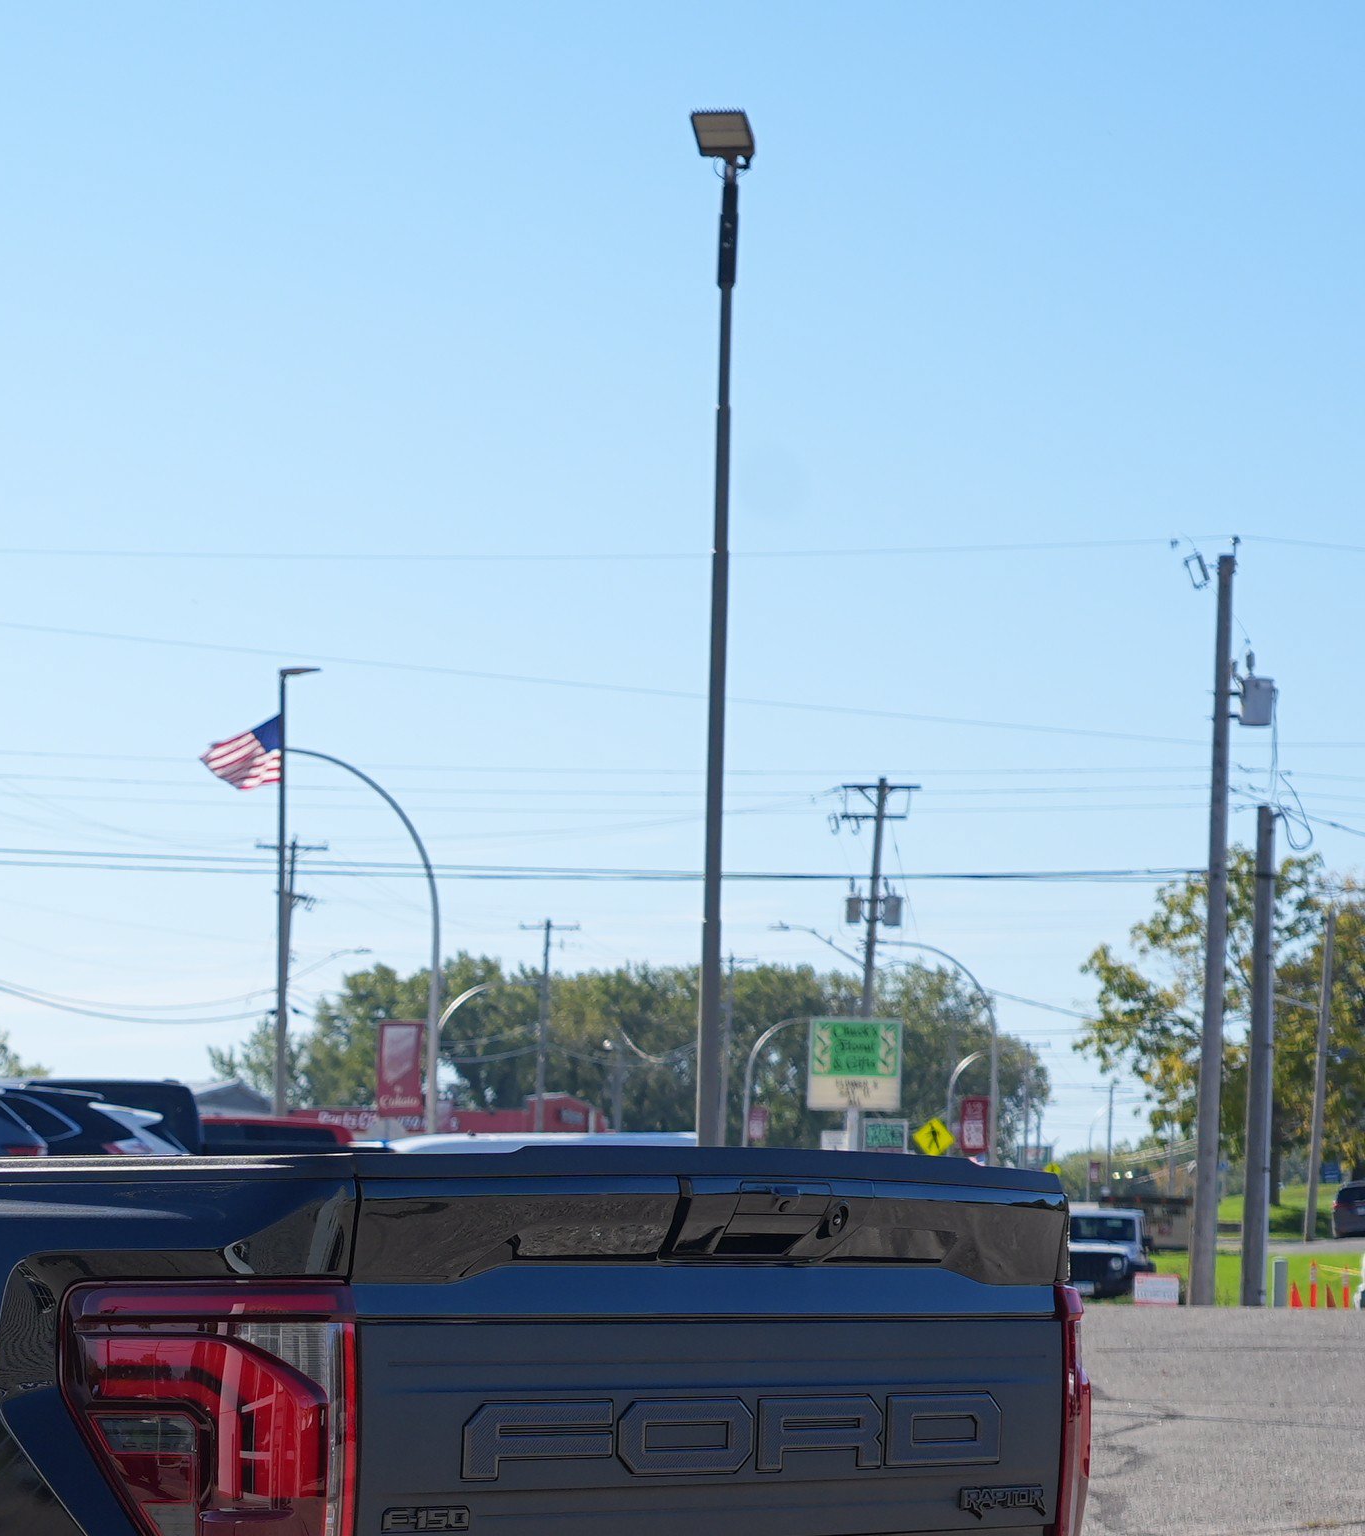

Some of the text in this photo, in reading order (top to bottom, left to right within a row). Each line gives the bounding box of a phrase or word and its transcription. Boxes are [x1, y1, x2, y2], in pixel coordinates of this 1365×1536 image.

[461, 1391, 1002, 1482] FORD
[382, 1504, 470, 1533] F-150
[959, 1484, 1046, 1520] RAPTOR
